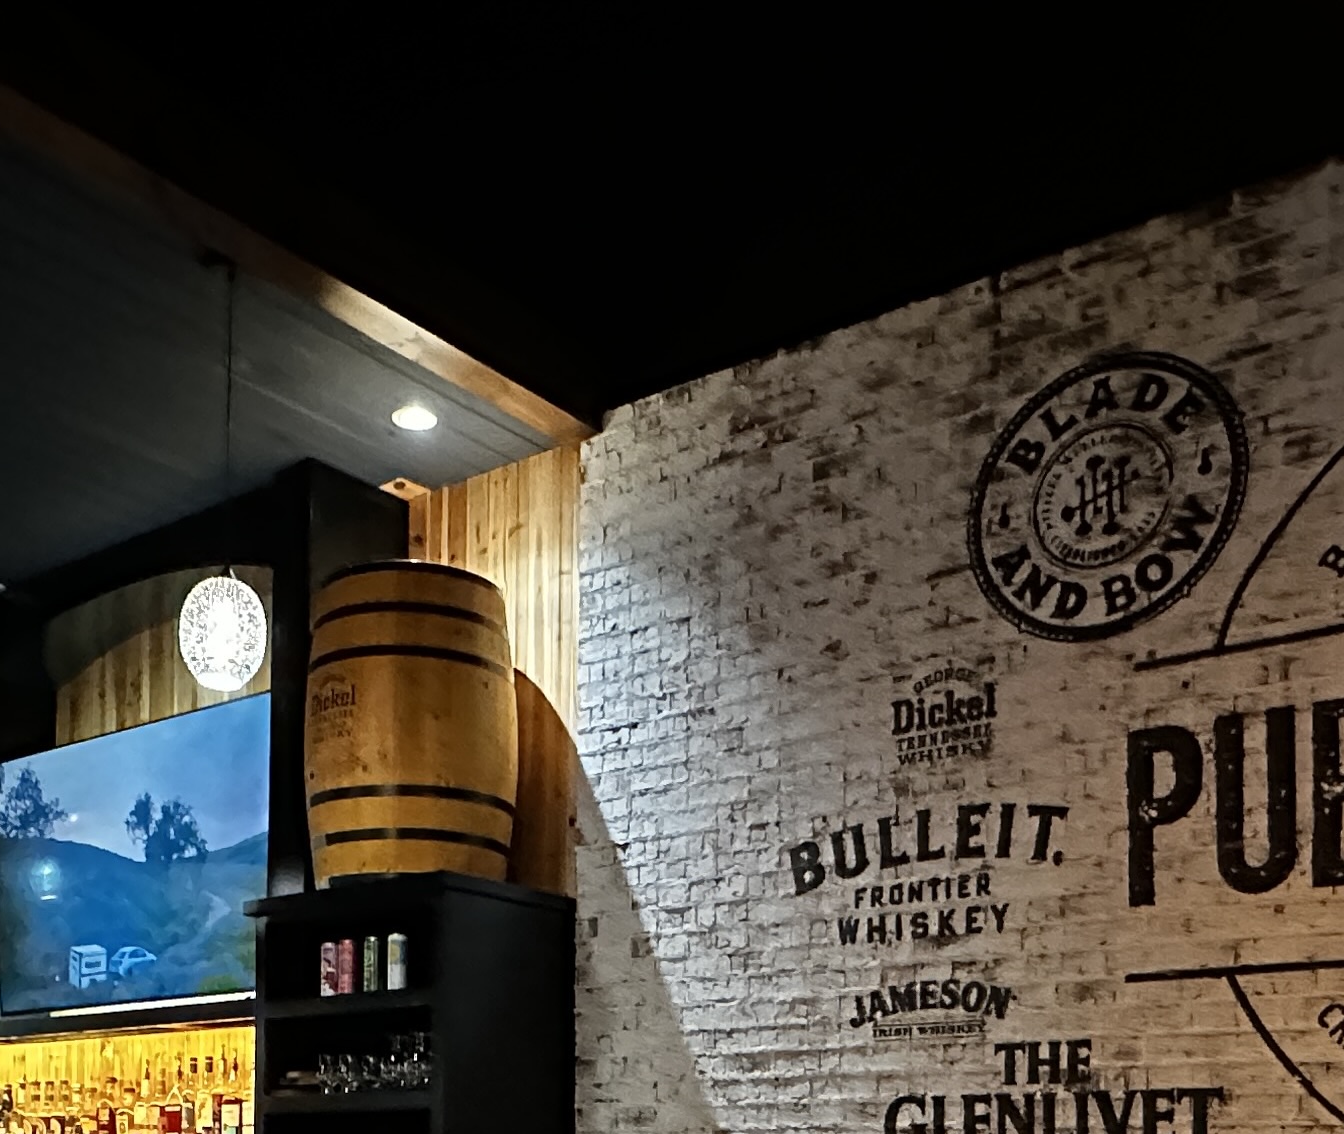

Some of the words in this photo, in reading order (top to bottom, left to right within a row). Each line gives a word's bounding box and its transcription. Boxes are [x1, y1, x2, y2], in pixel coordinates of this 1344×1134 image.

[1006, 373, 1206, 475] BLADE
[991, 545, 1088, 619] AND
[1101, 495, 1216, 617] BOW
[891, 682, 997, 736] Dickel
[854, 872, 992, 909] FRONTIER
[837, 903, 1009, 946] WHISKEY
[994, 1038, 1093, 1086] THE
